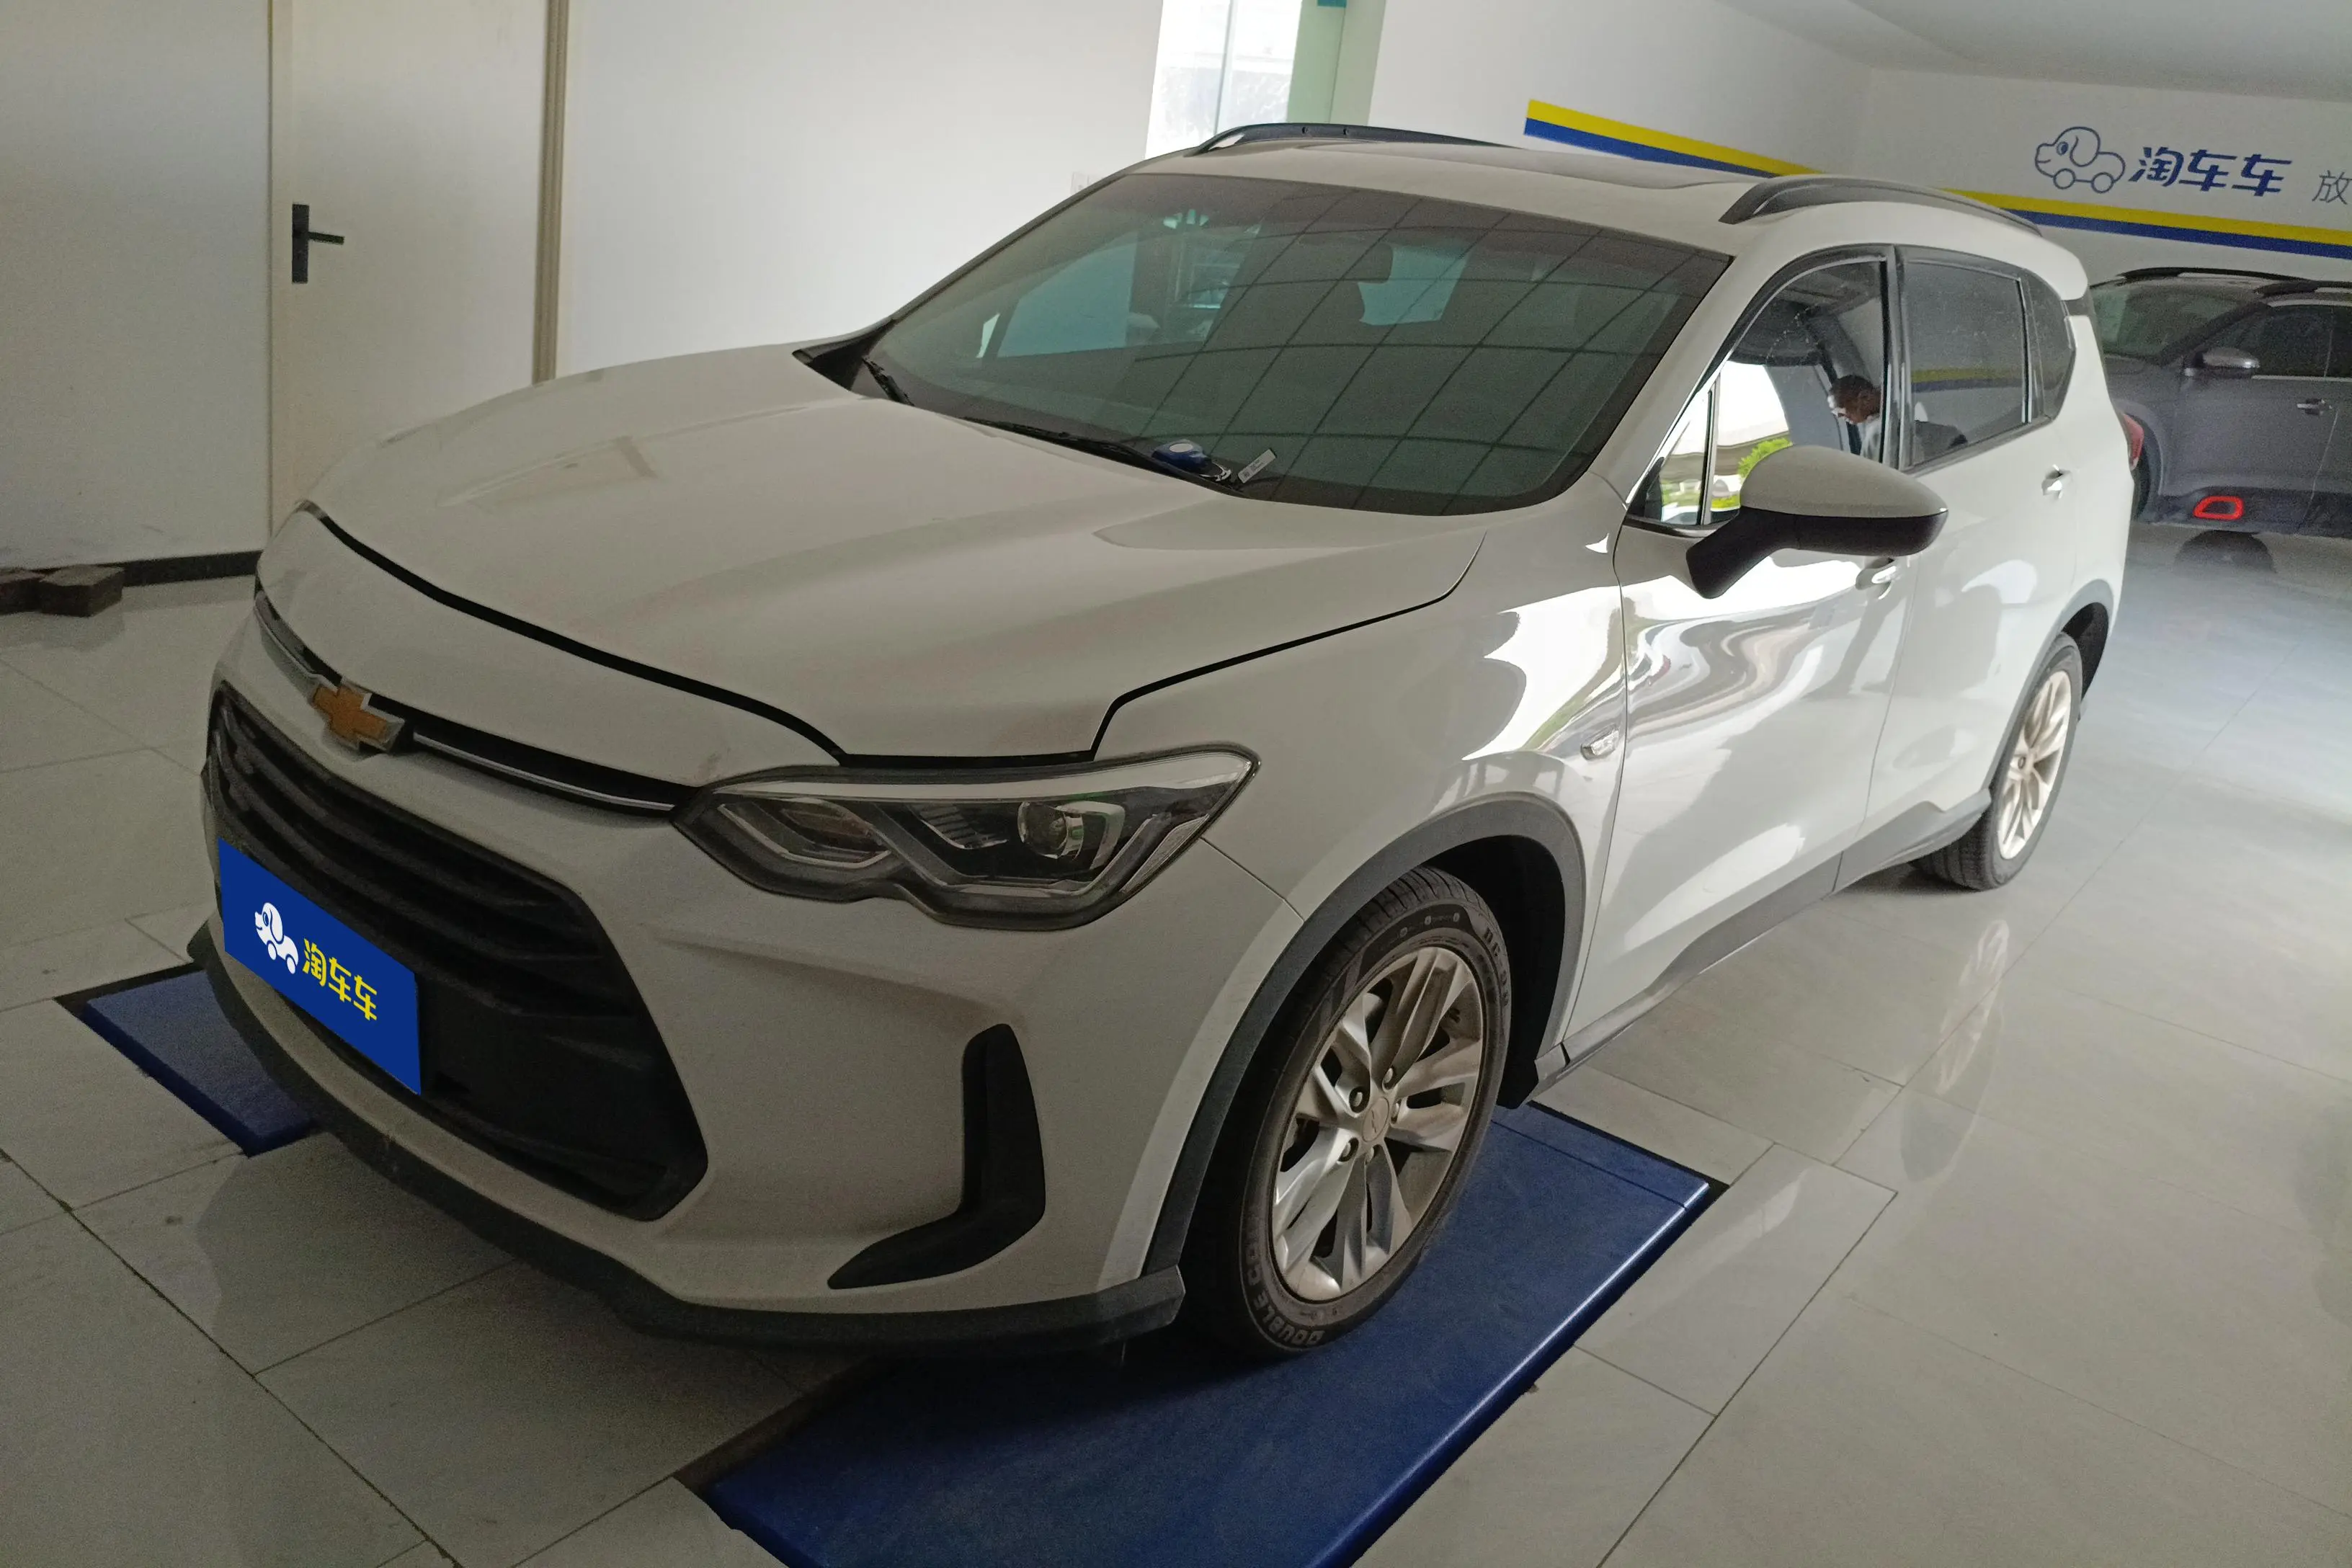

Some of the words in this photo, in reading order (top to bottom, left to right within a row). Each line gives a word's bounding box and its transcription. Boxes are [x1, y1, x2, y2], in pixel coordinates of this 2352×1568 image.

[2128, 146, 2292, 197] 淘车车
[2312, 169, 2352, 205] 放
[1253, 1289, 1325, 1346] DOUBLE
